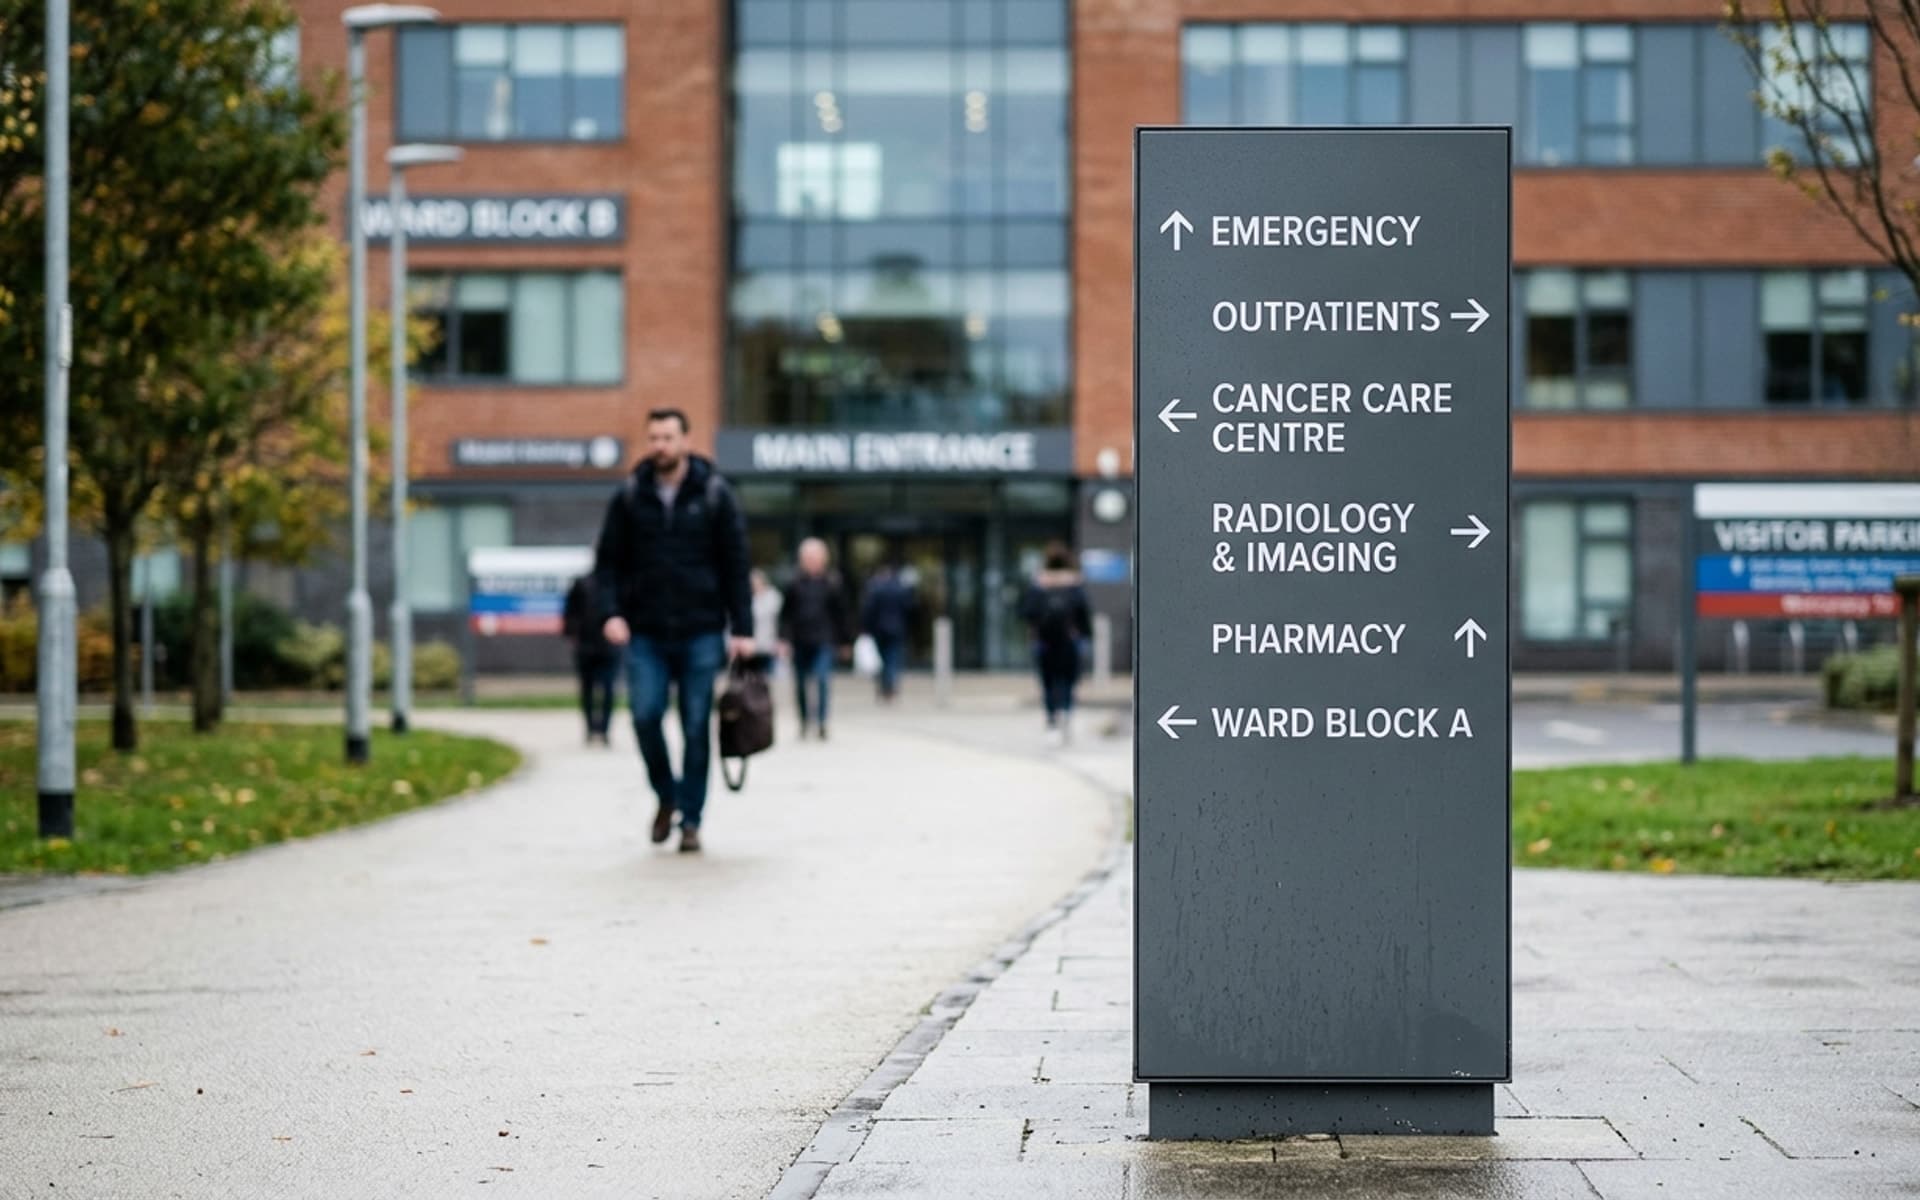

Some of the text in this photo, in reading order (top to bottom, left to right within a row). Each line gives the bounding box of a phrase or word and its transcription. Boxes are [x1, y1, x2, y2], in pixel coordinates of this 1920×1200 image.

[472, 200, 585, 237] BLOCK
[588, 200, 617, 237] B
[1212, 215, 1421, 246] EMERGENCY
[1212, 302, 1441, 331] OUTPATIENTS
[1212, 383, 1452, 413] CANCER CARE
[753, 432, 1036, 471] MAIN ENTRANCE
[1212, 423, 1345, 452] CENTRE
[1212, 503, 1415, 533] RADIOLOGY
[1714, 521, 1920, 551] VISITOR PARKI
[1212, 542, 1397, 572] & IMAGING
[1212, 624, 1406, 653] PHARMACY
[1211, 708, 1473, 738] WARD BLOCK A
